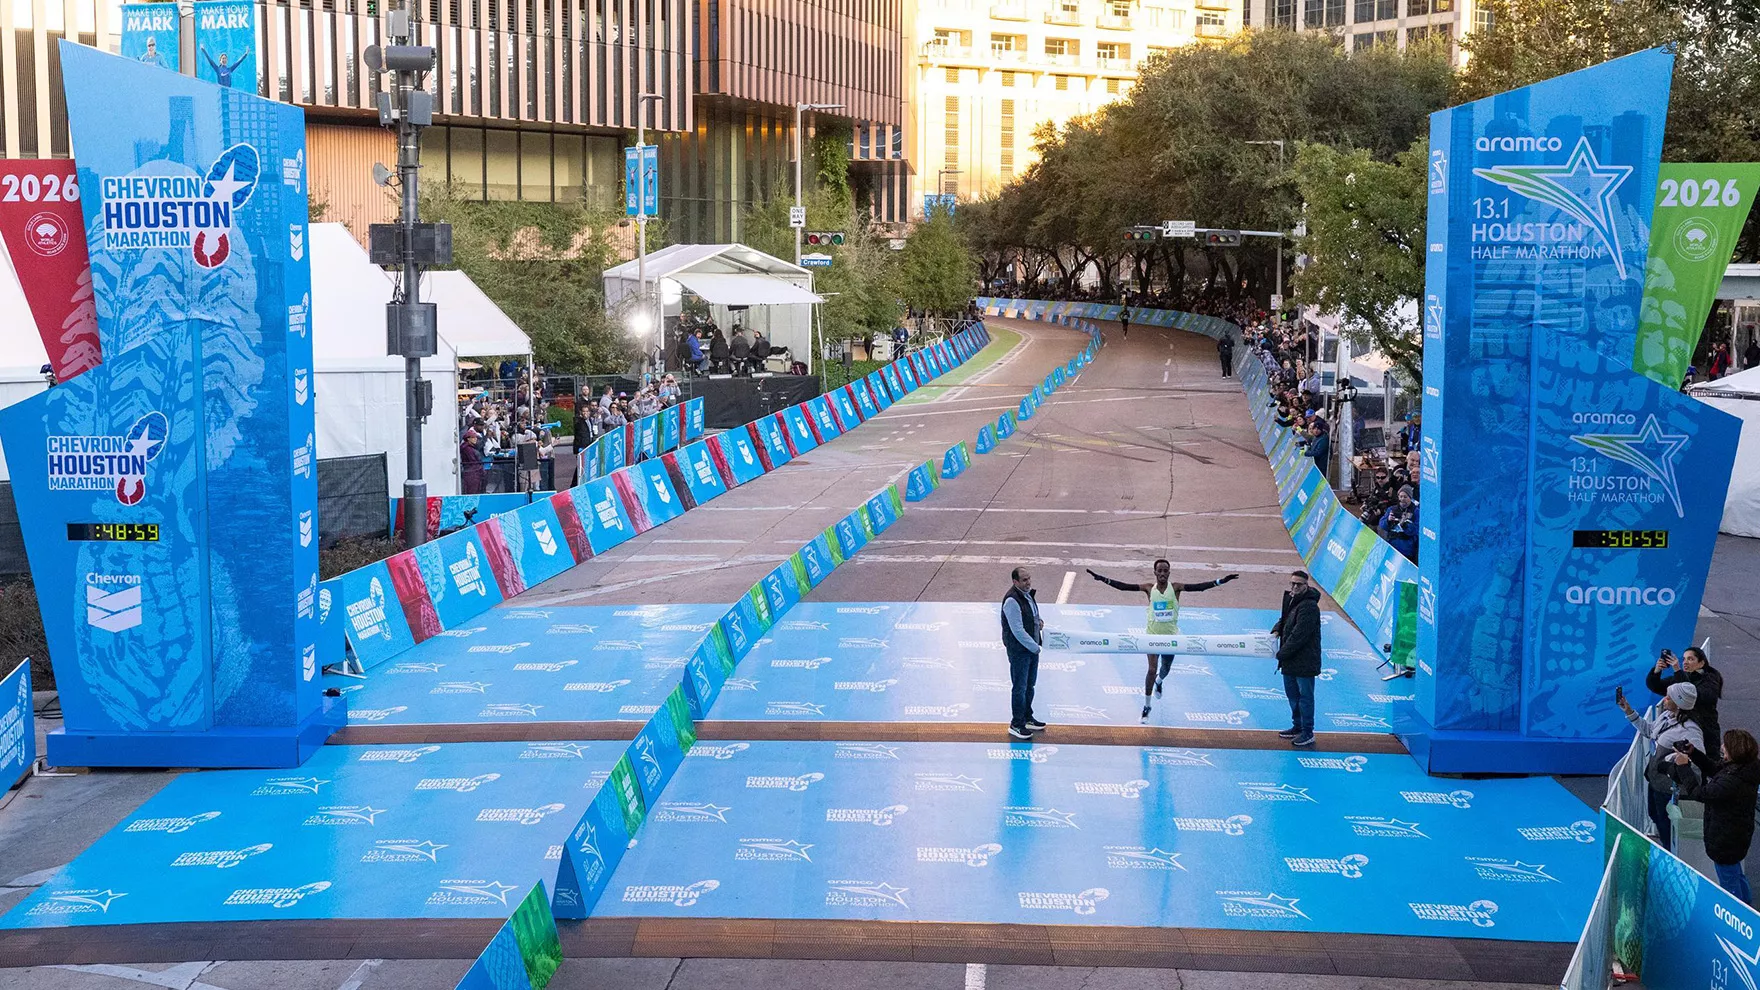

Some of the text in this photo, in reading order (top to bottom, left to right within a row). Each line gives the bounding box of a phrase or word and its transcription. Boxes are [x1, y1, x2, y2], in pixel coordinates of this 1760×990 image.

[127, 8, 173, 17] MAKE YOUR
[226, 5, 248, 14] YOUR
[127, 17, 174, 32] MARK
[201, 14, 248, 30] MARK
[1476, 136, 1562, 152] aramco
[2, 174, 80, 202] 2026
[104, 178, 200, 199] CHEVRON
[1658, 179, 1740, 207] 2026
[1472, 198, 1508, 218] 13.1
[105, 202, 231, 230] HOUSTON
[106, 232, 190, 248] MARATHON
[1472, 223, 1583, 242] HOUSTON
[1471, 246, 1601, 260] HALF MARATHON
[1573, 412, 1636, 424] aramco
[48, 438, 122, 452] CHEVRON
[50, 455, 146, 475] HOUSTON
[1570, 457, 1597, 473] 13.1
[50, 478, 114, 488] MARATHON
[1569, 476, 1650, 490] HOUSTON
[1568, 492, 1664, 503] HALF MARATHON
[1327, 538, 1346, 562] aramco
[86, 573, 140, 584] Chevron
[1566, 586, 1676, 606] aramco
[346, 597, 376, 618] CHEVRON
[351, 606, 386, 632] HOUSTON
[127, 821, 196, 829] HOUSTON
[174, 854, 248, 862] HOUSTON
[226, 892, 306, 901] HOUSTON
[623, 890, 699, 898] HOUSTON
[1019, 897, 1095, 906] HOUSTON
[1408, 902, 1467, 912] CHEVRON
[1413, 909, 1490, 918] HOUSTON
[1714, 904, 1753, 940] aramco
[1712, 958, 1728, 986] 13.1
